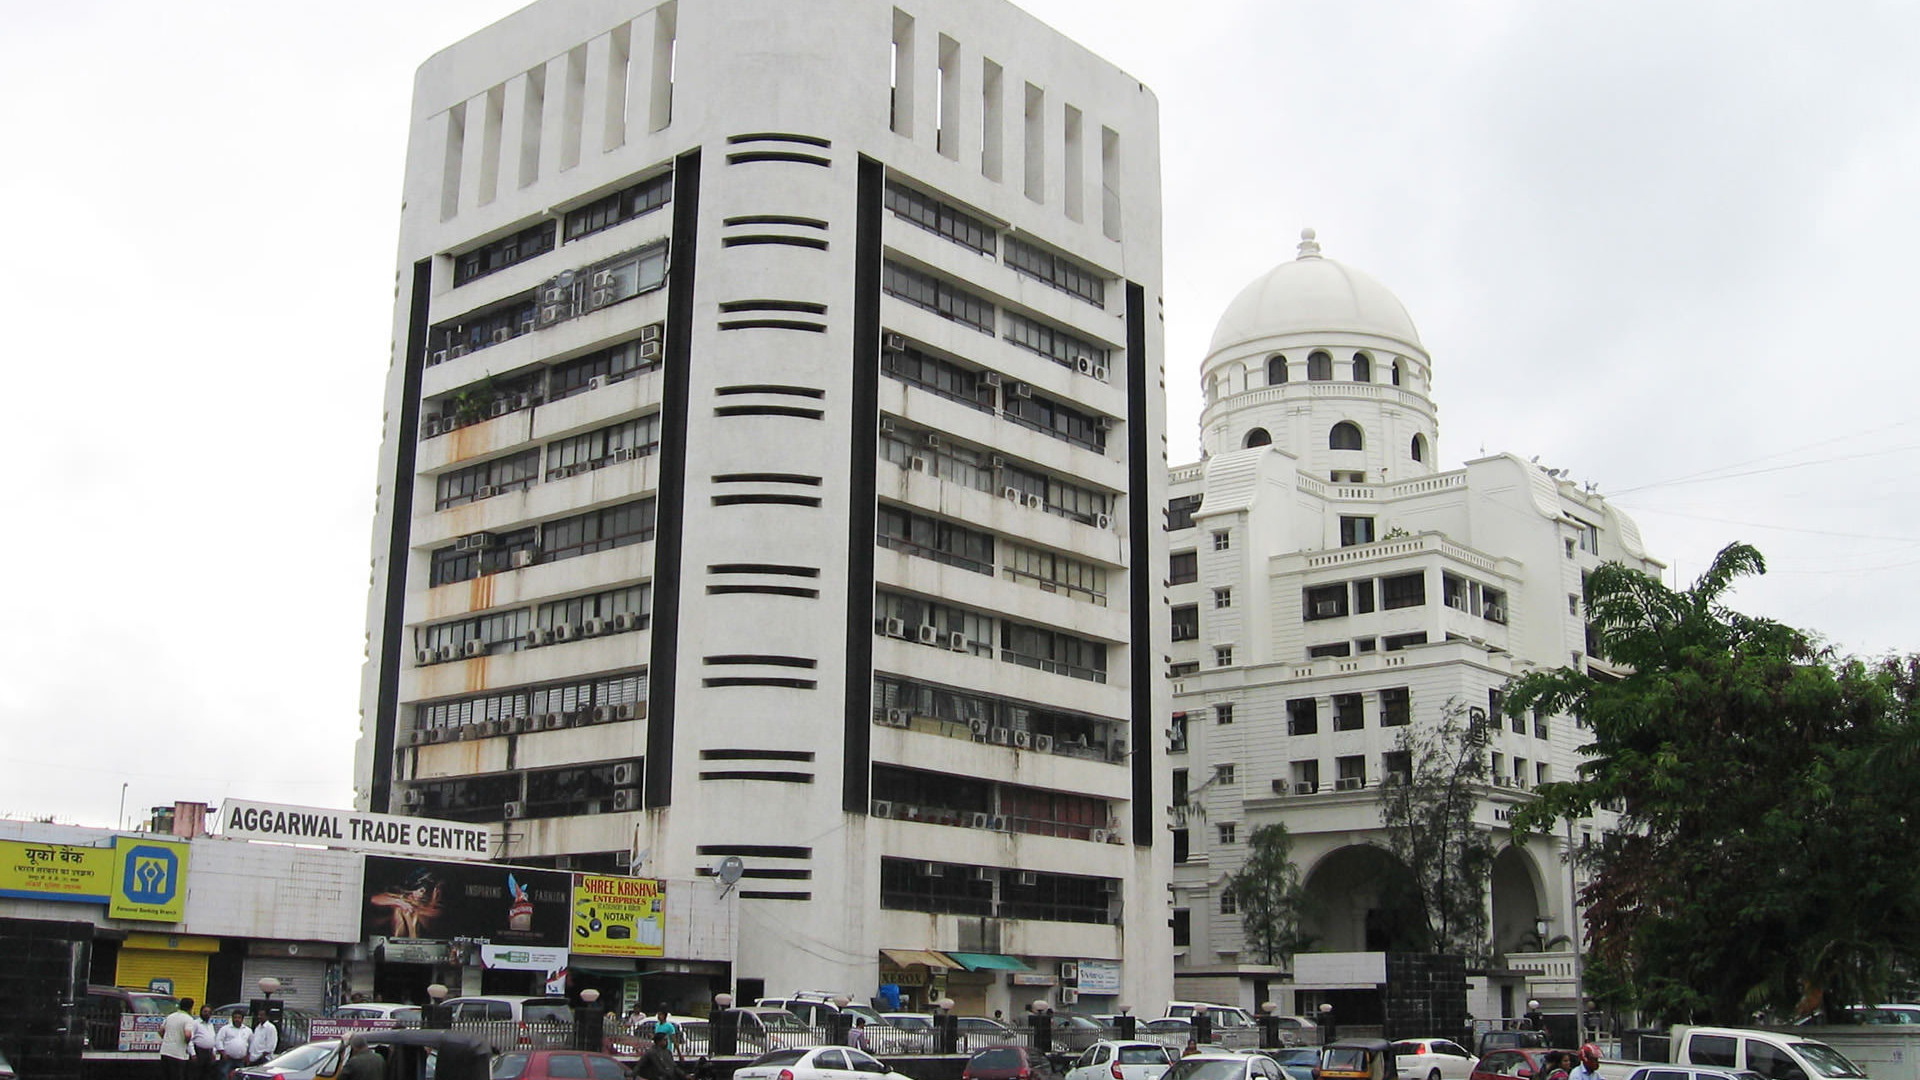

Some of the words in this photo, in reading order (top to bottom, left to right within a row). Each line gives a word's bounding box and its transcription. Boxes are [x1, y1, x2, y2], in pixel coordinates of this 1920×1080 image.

[229, 807, 342, 839] AGGARWAL
[350, 818, 411, 845] TRADE
[416, 825, 487, 852] CENTRE
[25, 845, 56, 865] यूको
[60, 845, 85, 864] बैंक
[584, 879, 615, 895] SHREE
[618, 882, 657, 897] KRISHNA
[593, 895, 647, 905] ENTERPRISES
[603, 911, 635, 921] NOTARY
[881, 972, 923, 986] XEROX
